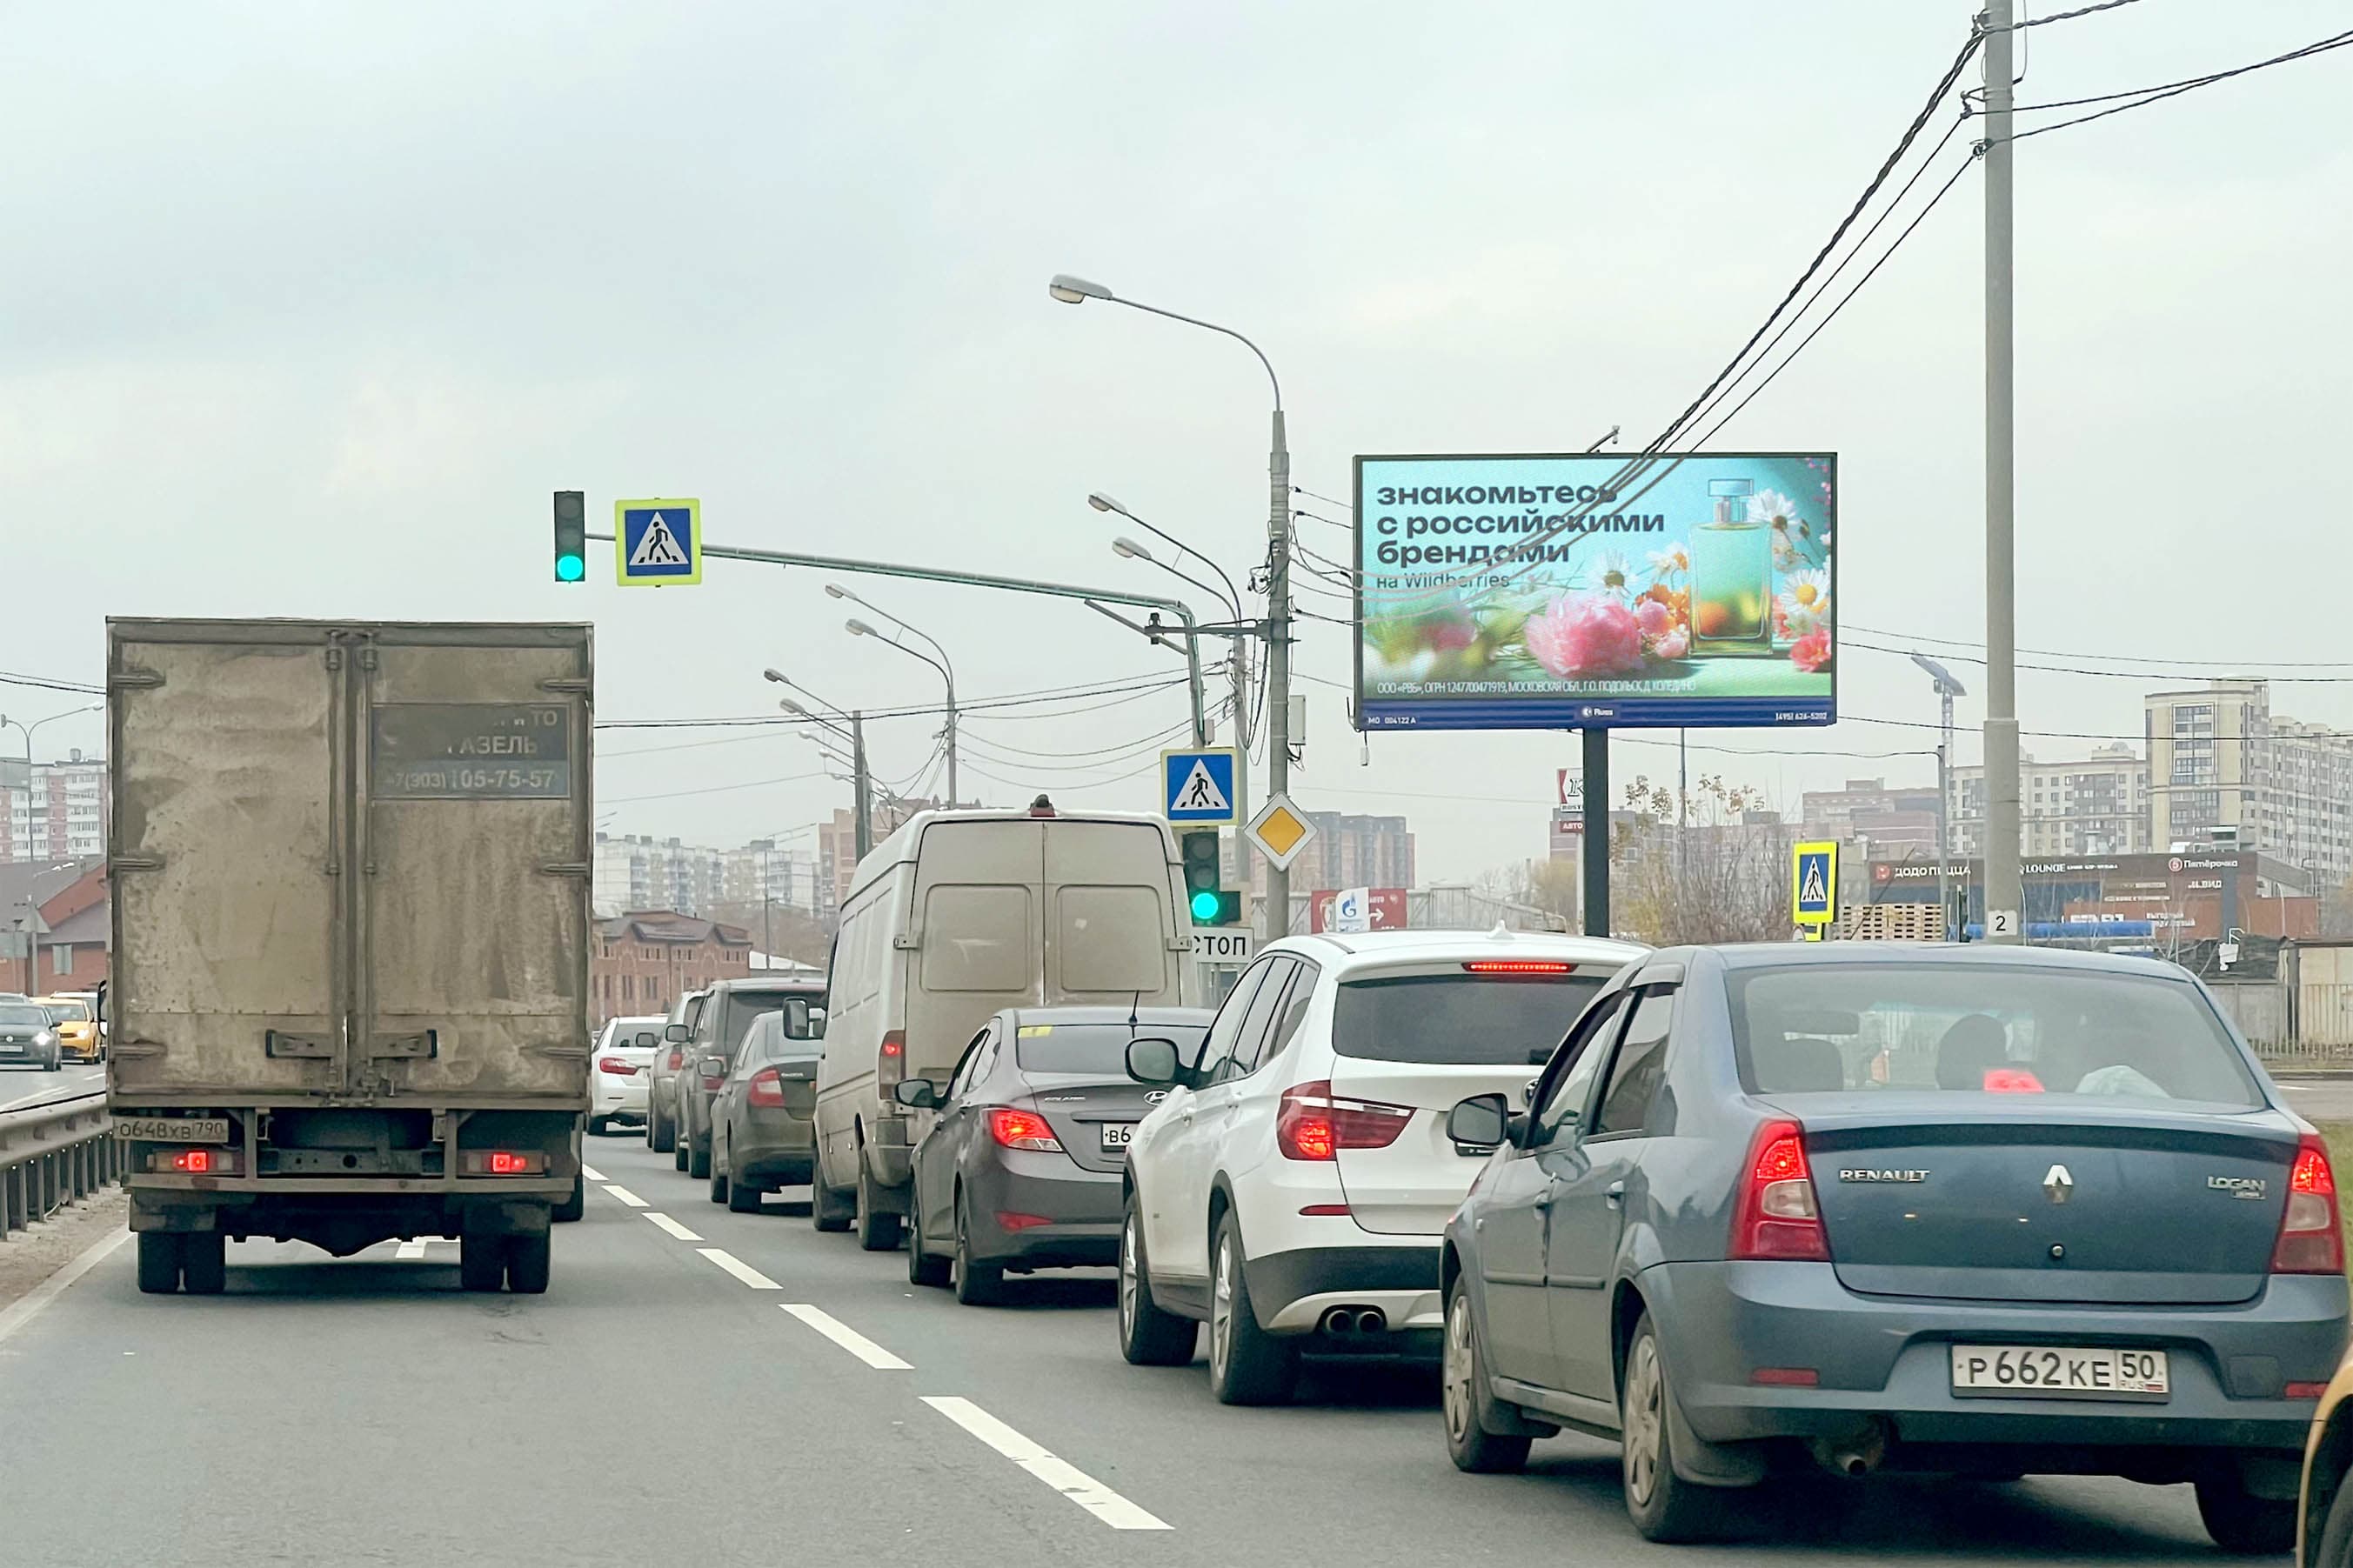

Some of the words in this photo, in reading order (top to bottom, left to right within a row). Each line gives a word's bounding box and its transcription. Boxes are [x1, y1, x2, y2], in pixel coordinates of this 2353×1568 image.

[1377, 484, 1618, 505] знакомьтесь
[1377, 516, 1398, 534] с
[1407, 508, 1665, 539] российскими
[1377, 540, 1569, 568] брендами
[1377, 576, 1398, 589] на
[447, 736, 538, 756] АЗЕЛЬ
[1894, 867, 1928, 878] ДОДО
[1995, 915, 2007, 931] 2
[1839, 1169, 1930, 1183] RENAULT
[2207, 1176, 2267, 1191] LOGAN
[2122, 1353, 2156, 1379] 50
